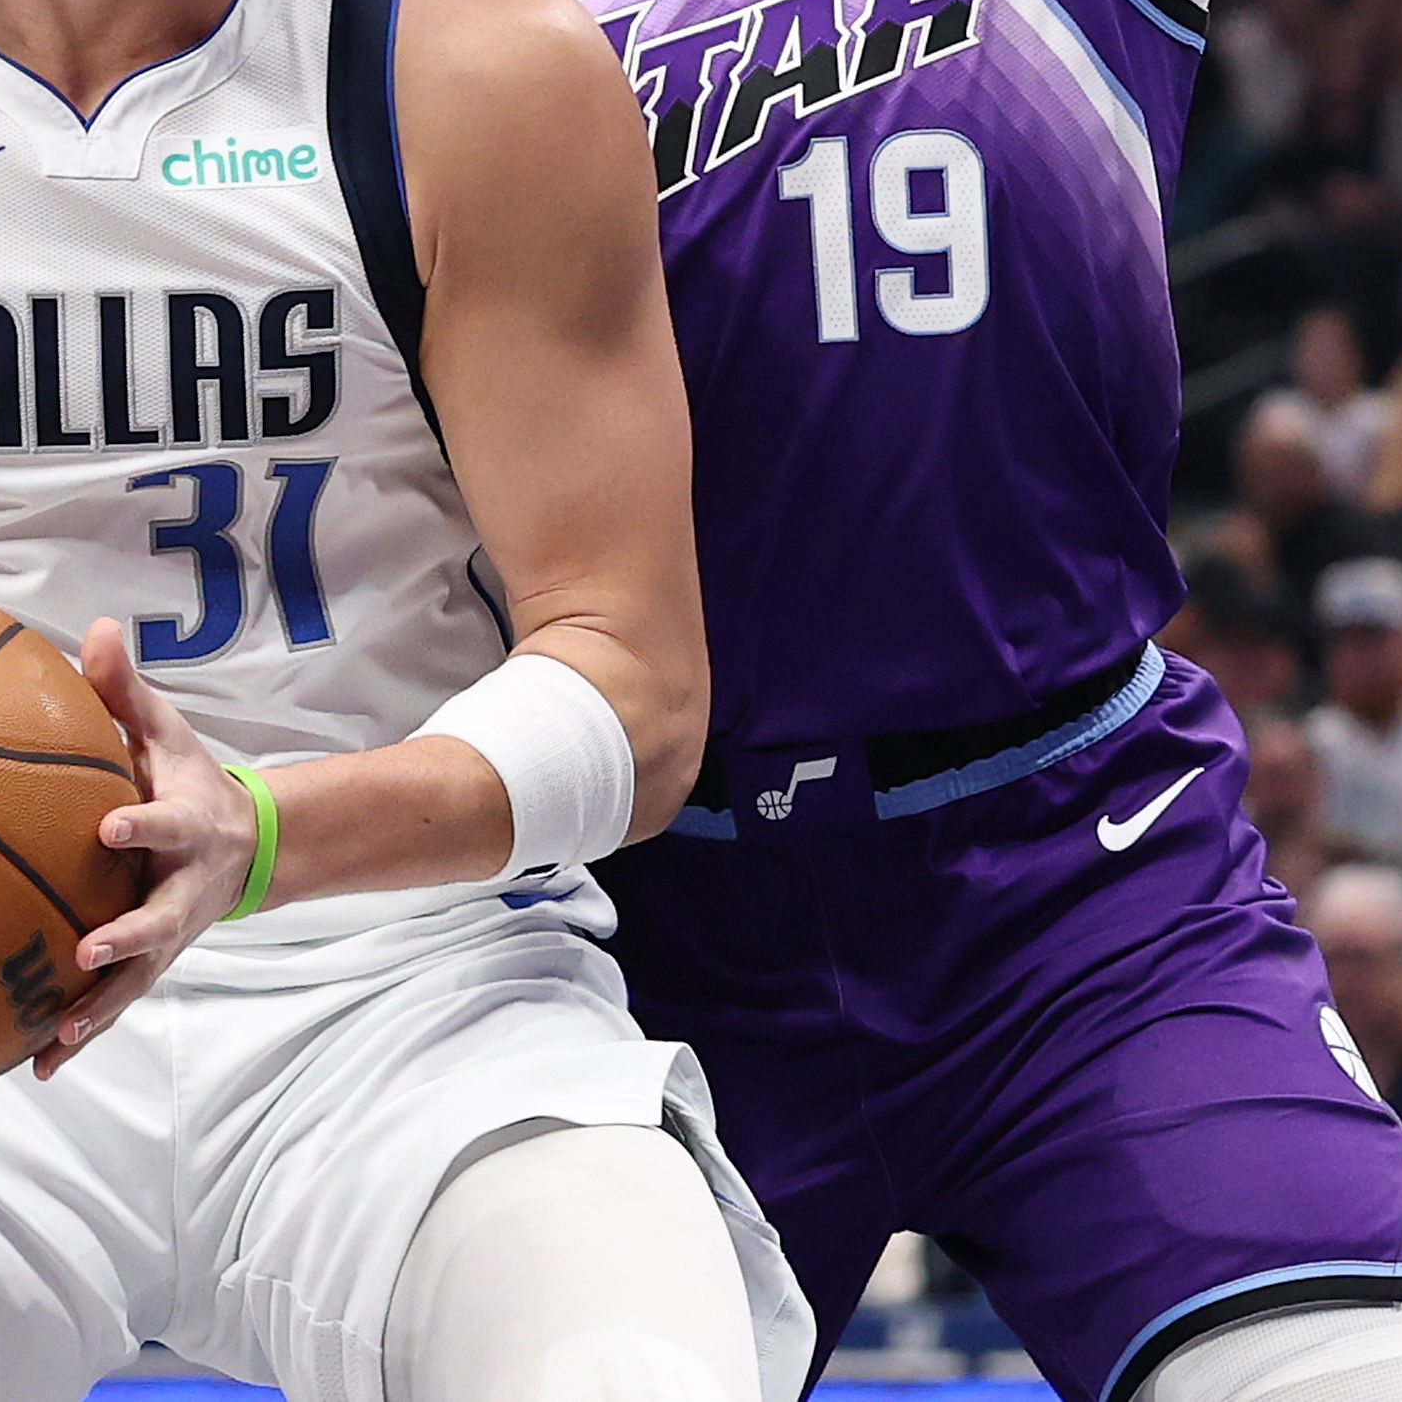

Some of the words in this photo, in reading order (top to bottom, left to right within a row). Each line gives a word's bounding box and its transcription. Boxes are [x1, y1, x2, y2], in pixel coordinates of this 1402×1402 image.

[161, 137, 318, 186] chime
[777, 128, 991, 343] 19
[126, 456, 339, 669] 31
